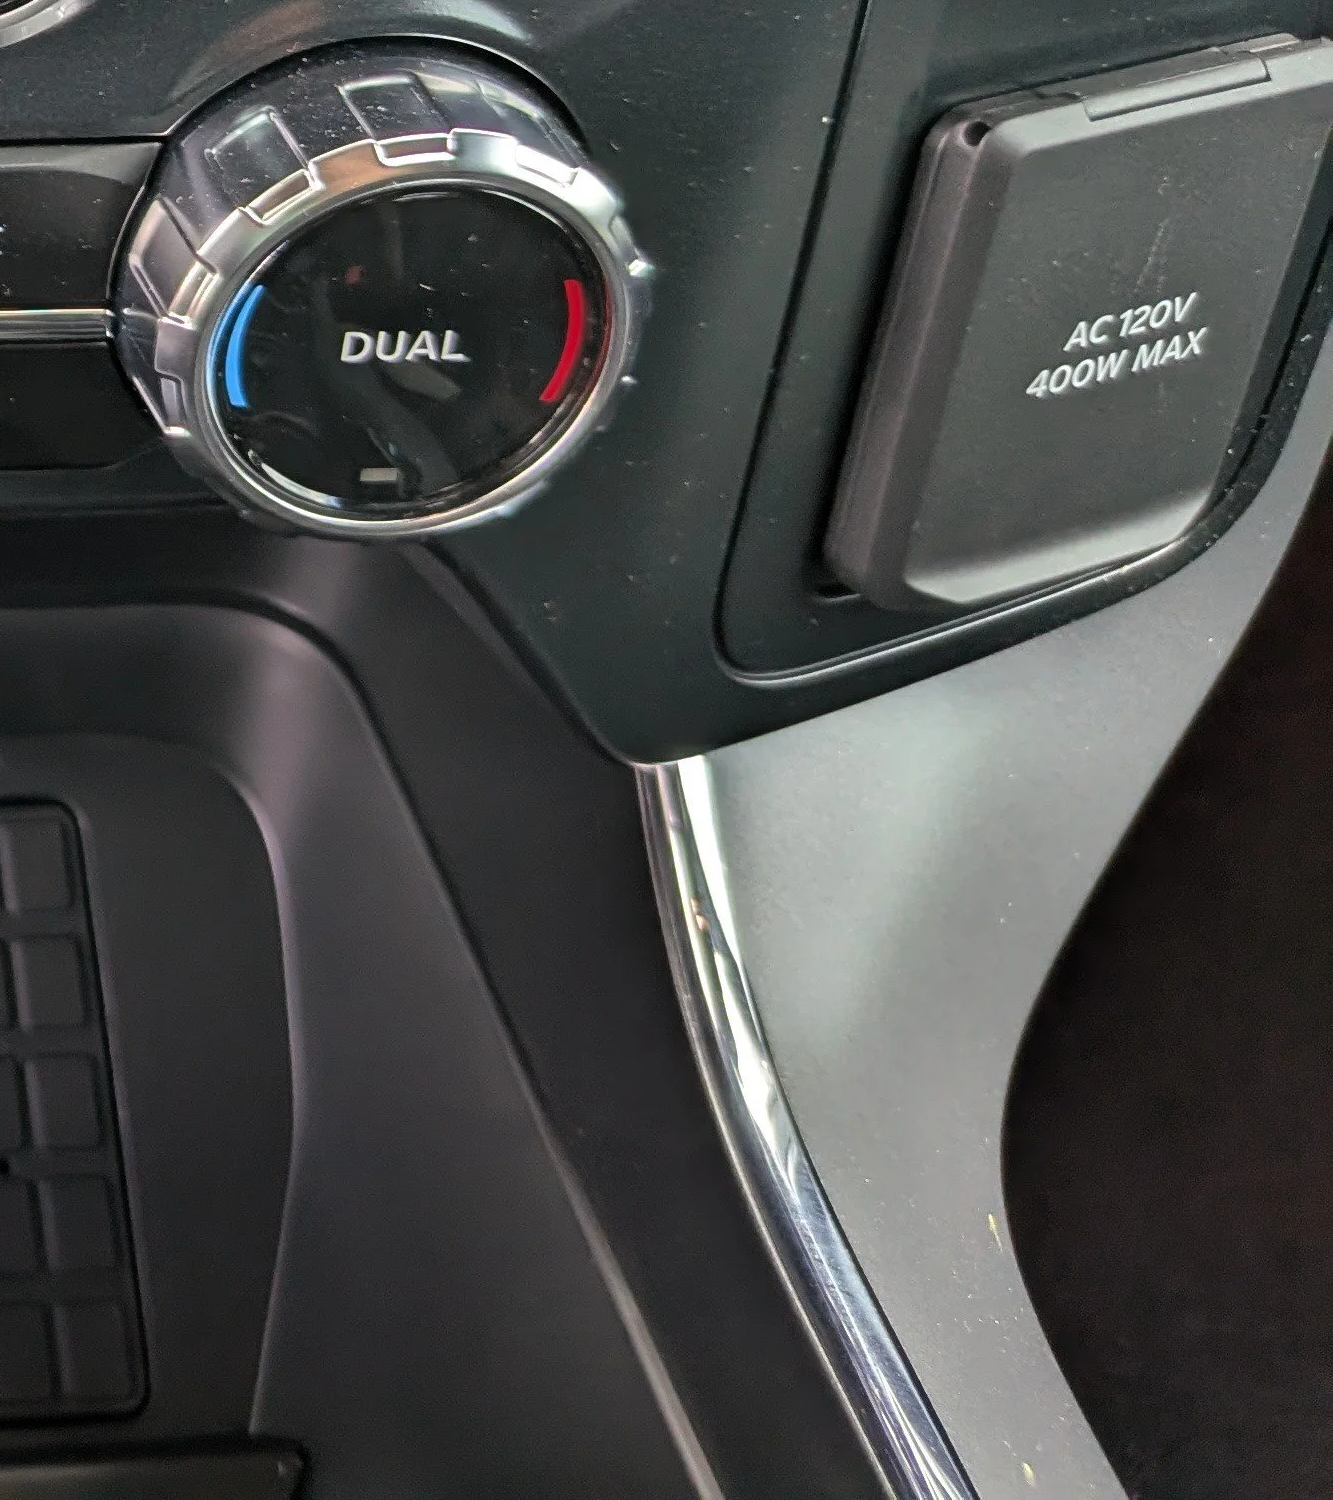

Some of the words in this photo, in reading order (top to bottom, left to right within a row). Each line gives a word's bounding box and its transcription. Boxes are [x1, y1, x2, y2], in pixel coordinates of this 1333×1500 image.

[340, 328, 471, 364] DUAL
[1062, 314, 1117, 351] AC
[1119, 291, 1198, 338] 120V
[1025, 348, 1129, 398] 400W
[1131, 326, 1209, 372] MAX
